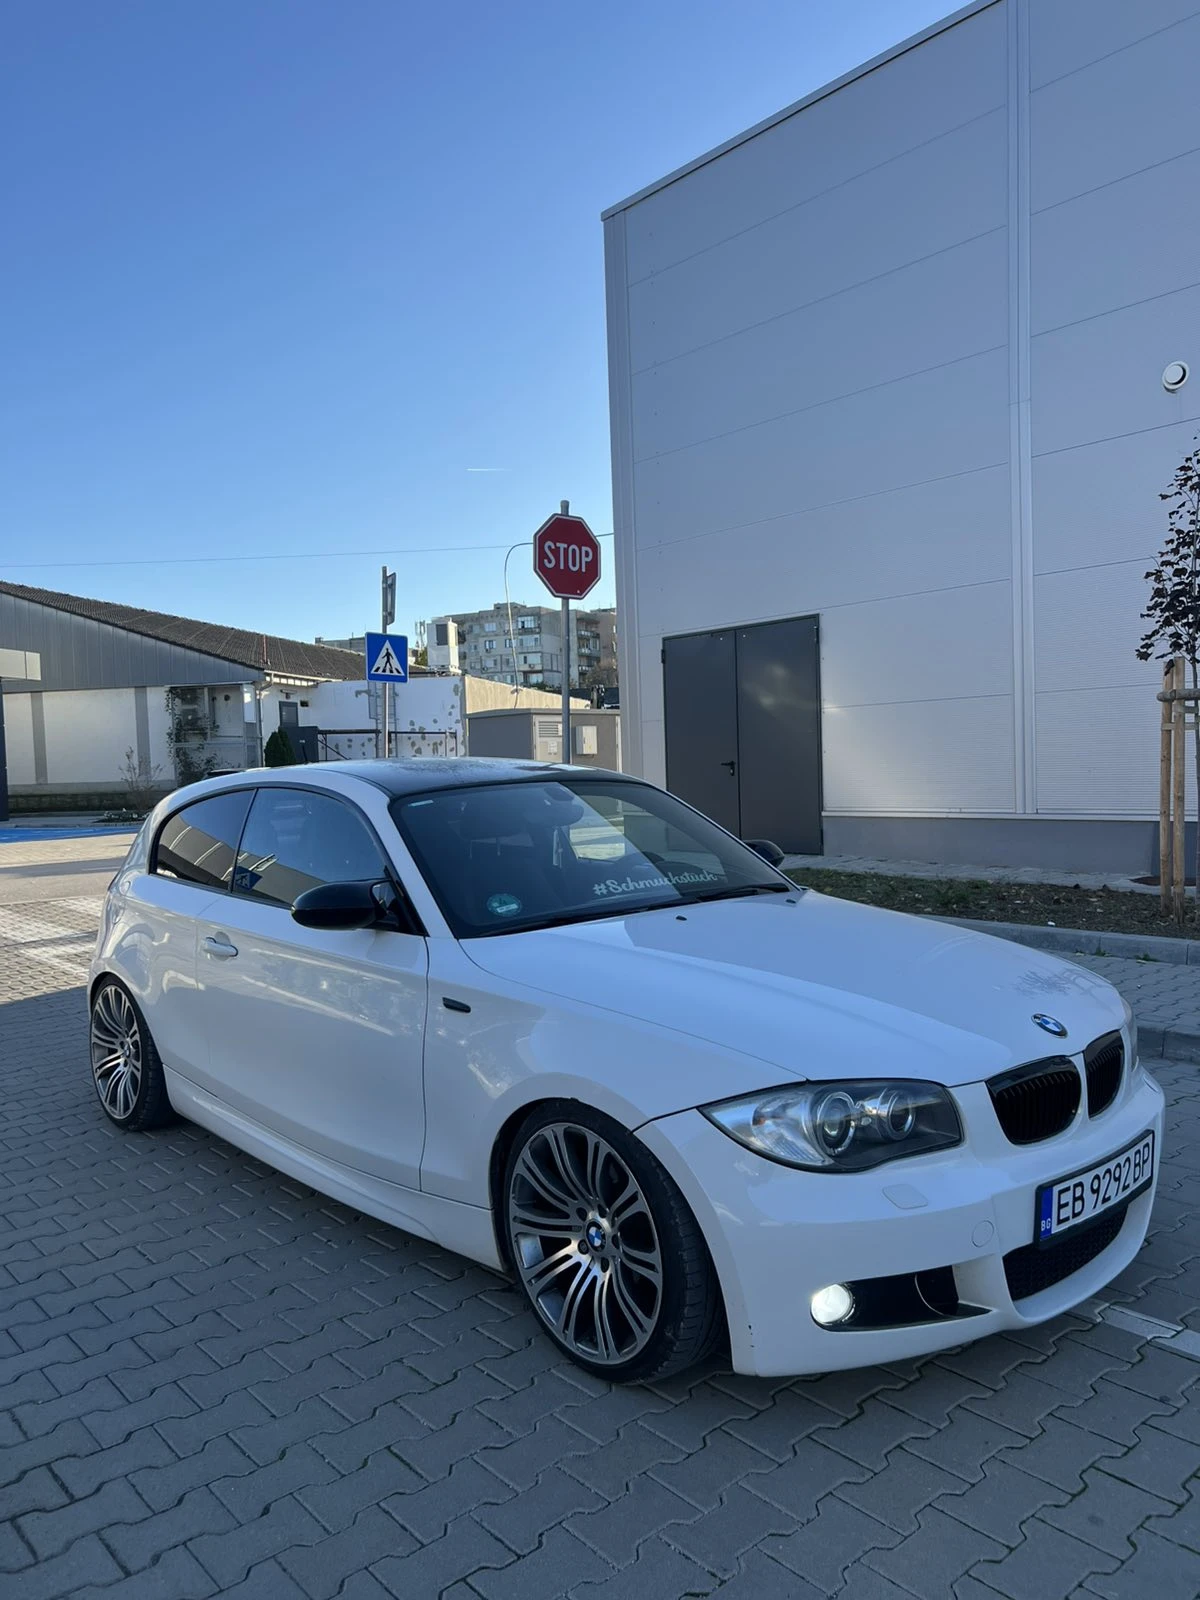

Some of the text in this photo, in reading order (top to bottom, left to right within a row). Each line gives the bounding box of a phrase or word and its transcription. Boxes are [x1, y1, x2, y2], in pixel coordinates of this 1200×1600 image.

[543, 540, 593, 573] STOP
[1056, 1142, 1150, 1226] EB 9292 BP
[1040, 1218, 1052, 1232] BG
